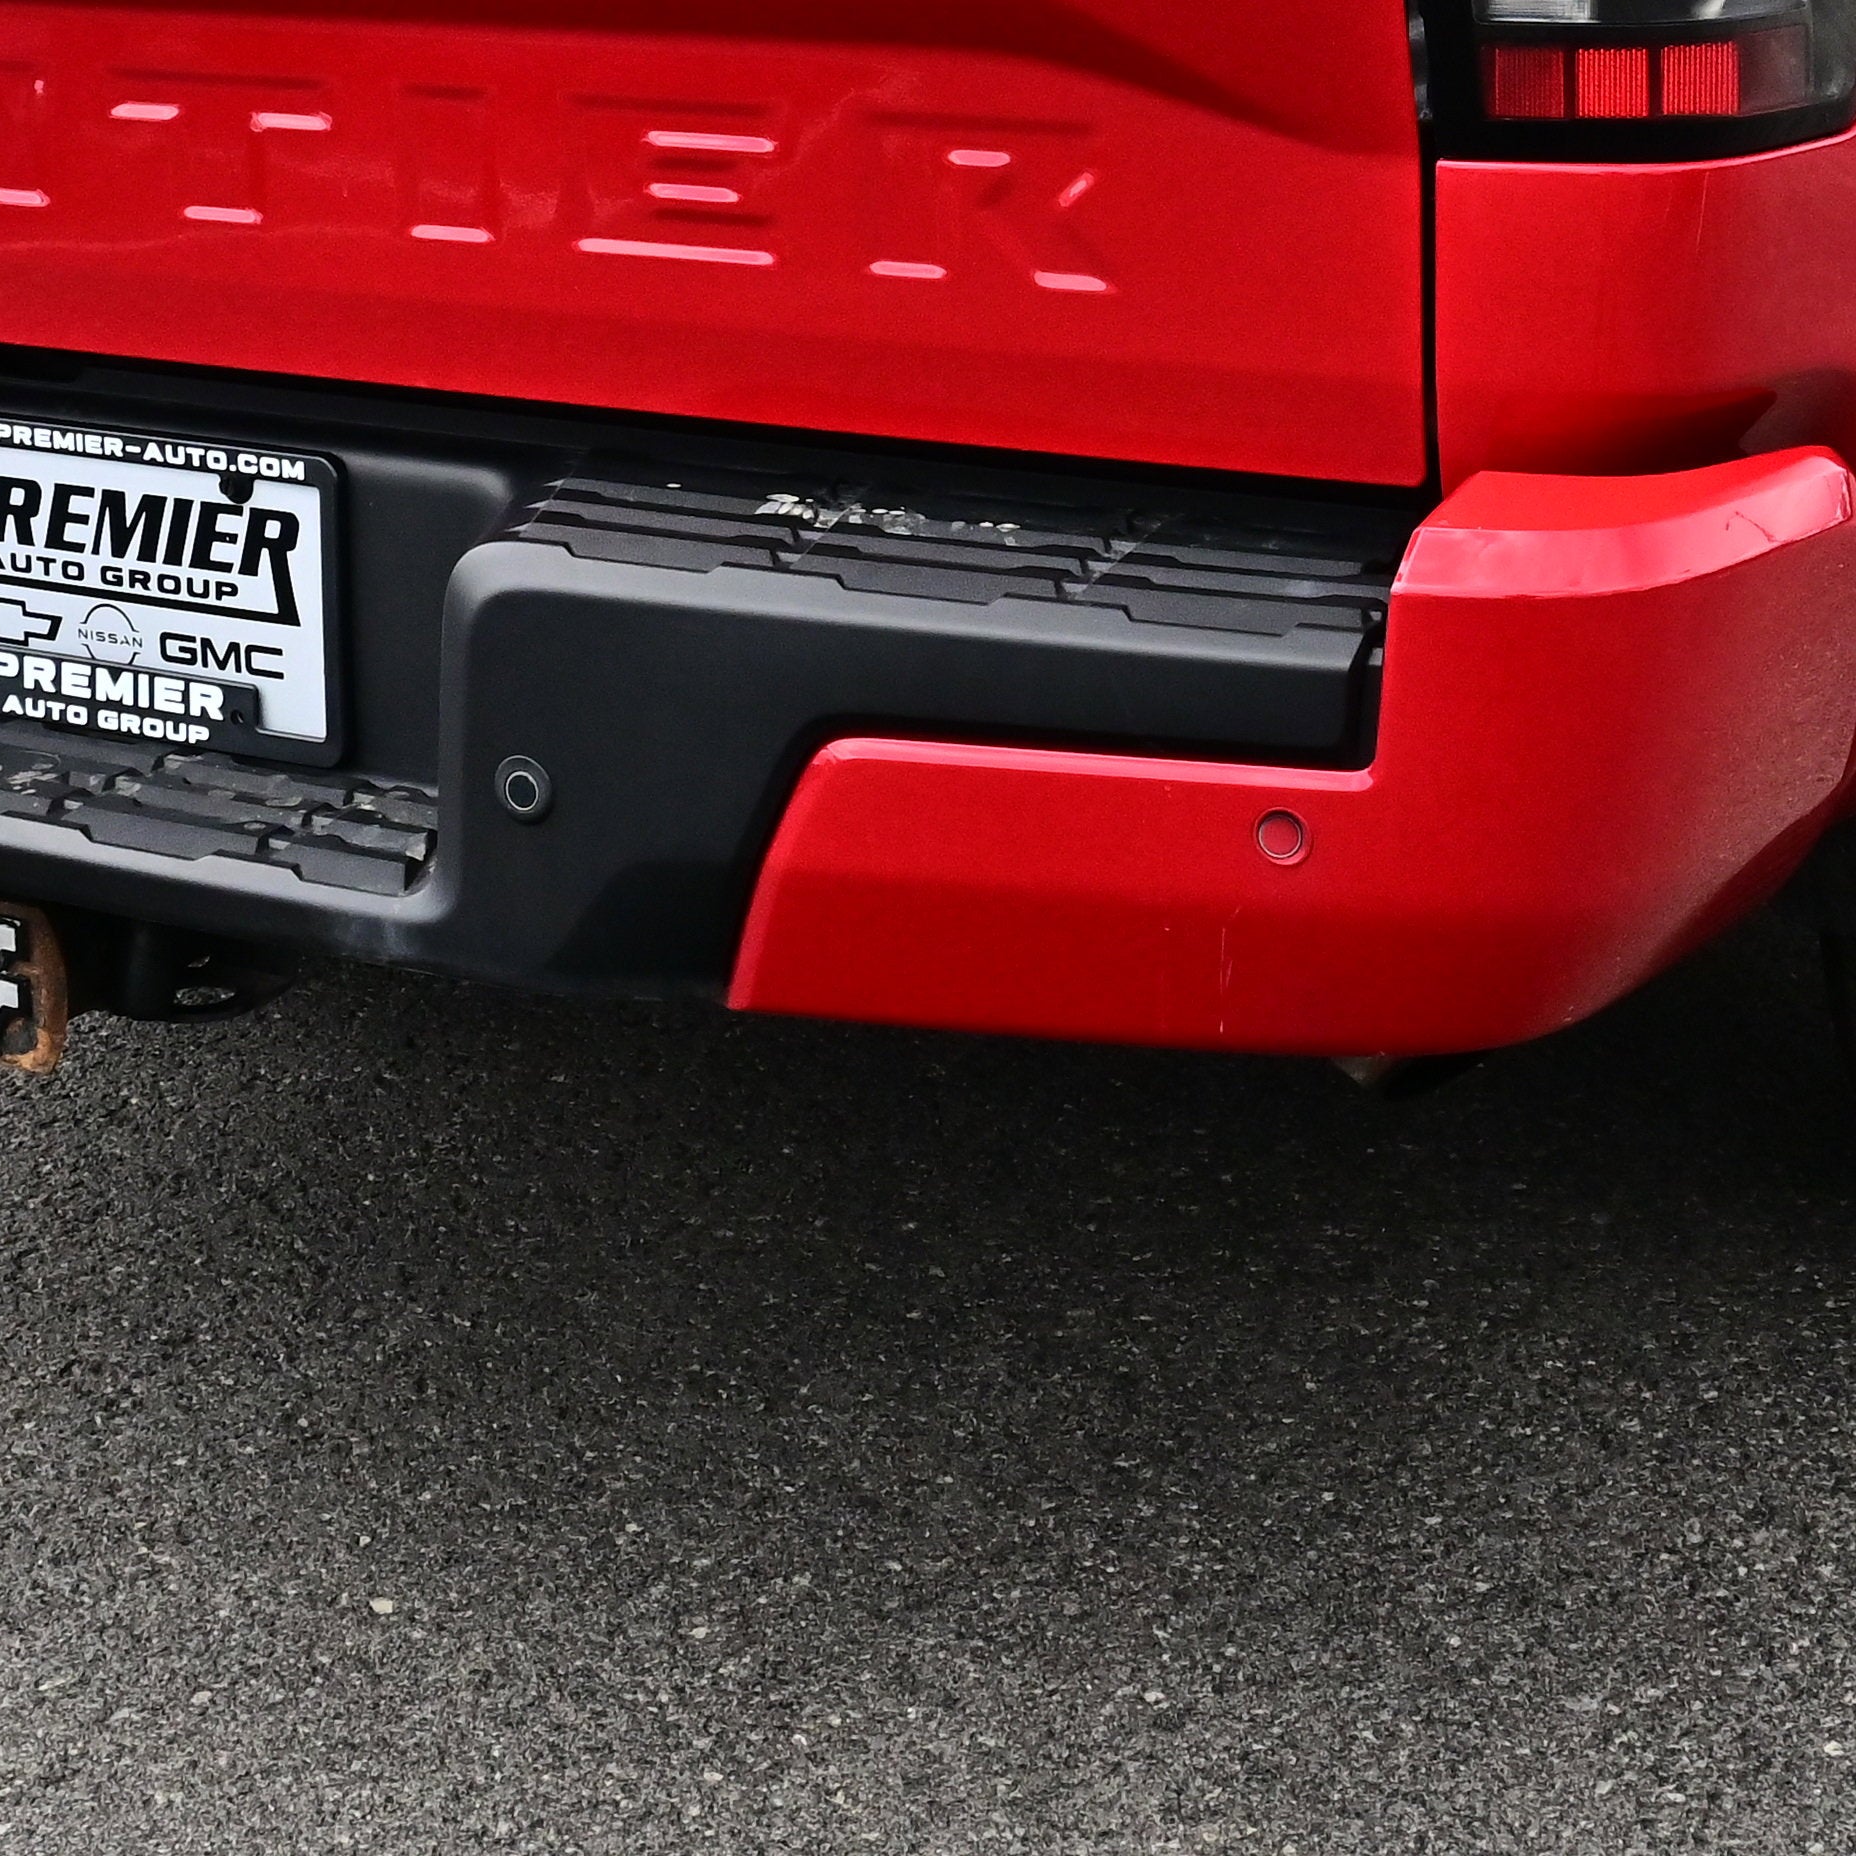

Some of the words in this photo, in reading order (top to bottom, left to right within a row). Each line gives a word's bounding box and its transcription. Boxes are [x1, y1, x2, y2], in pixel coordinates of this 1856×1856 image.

[100, 561, 239, 601] GROUP
[77, 626, 143, 649] NISSAN
[159, 631, 285, 680] GMC
[1, 693, 88, 727] AUTO
[96, 710, 210, 745] GROUP
